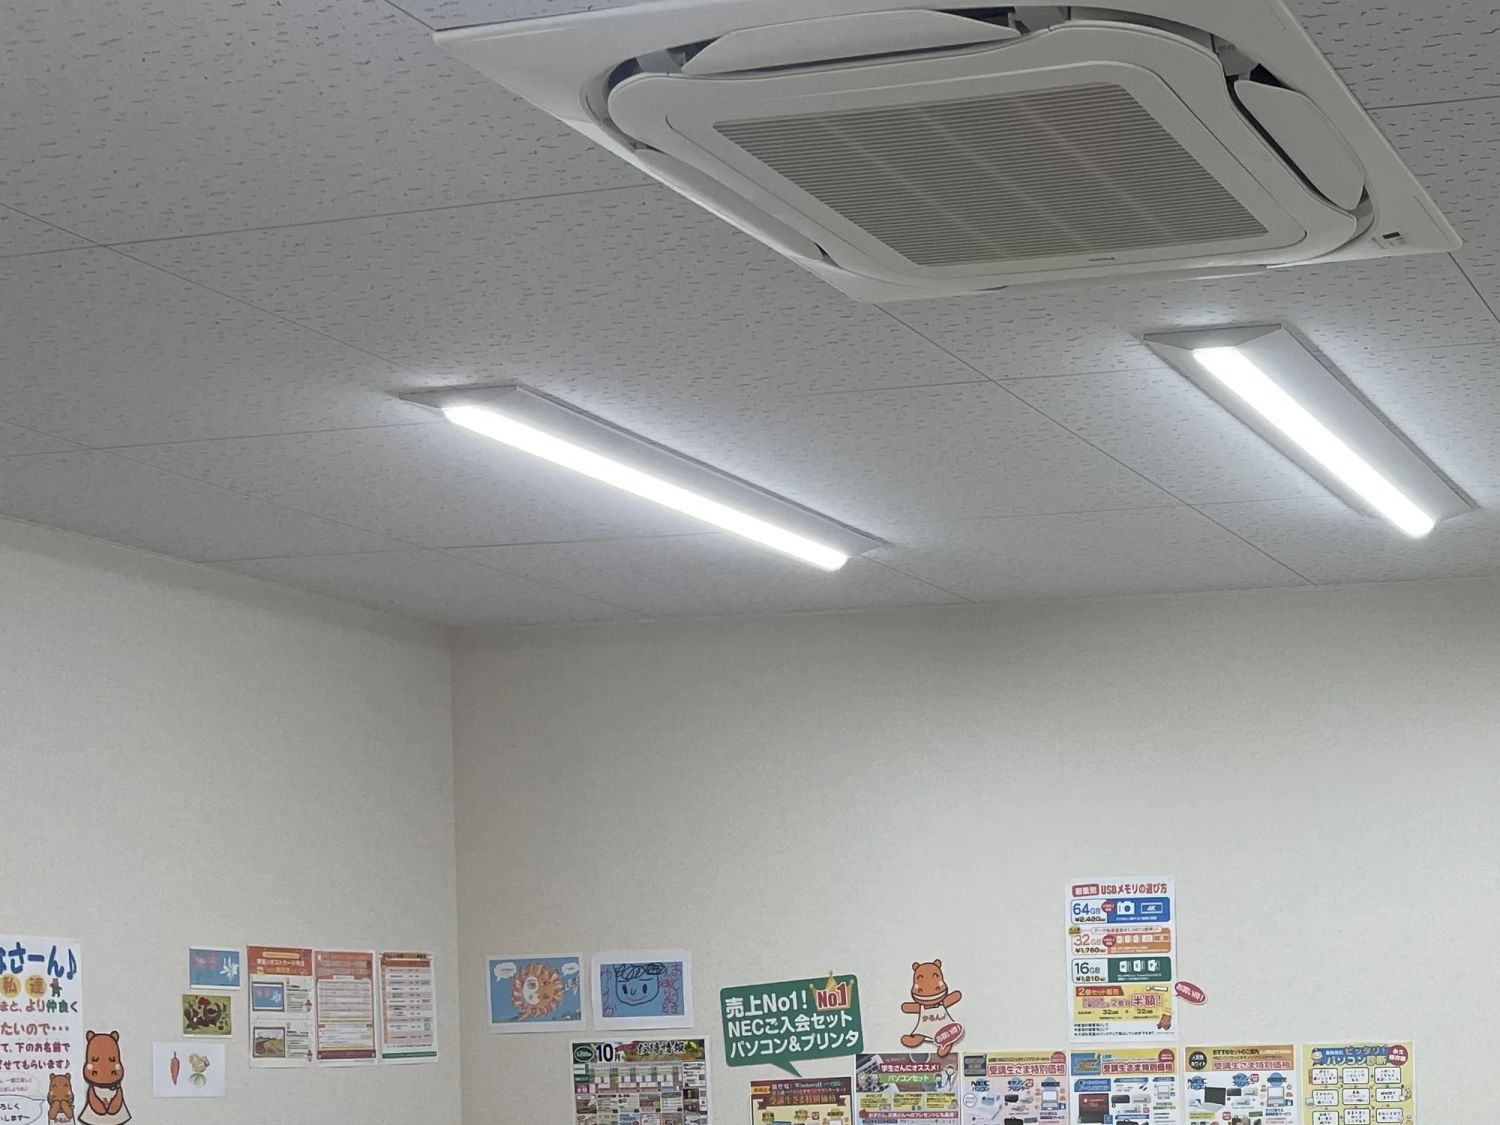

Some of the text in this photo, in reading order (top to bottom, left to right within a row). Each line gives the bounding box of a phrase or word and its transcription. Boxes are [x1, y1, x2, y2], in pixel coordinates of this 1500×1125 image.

[1101, 883, 1167, 894] USBメモリの選び方
[817, 982, 847, 1009] No1
[728, 1010, 852, 1038] NECご入会セット
[730, 1030, 859, 1059] パソコン&プリンタ
